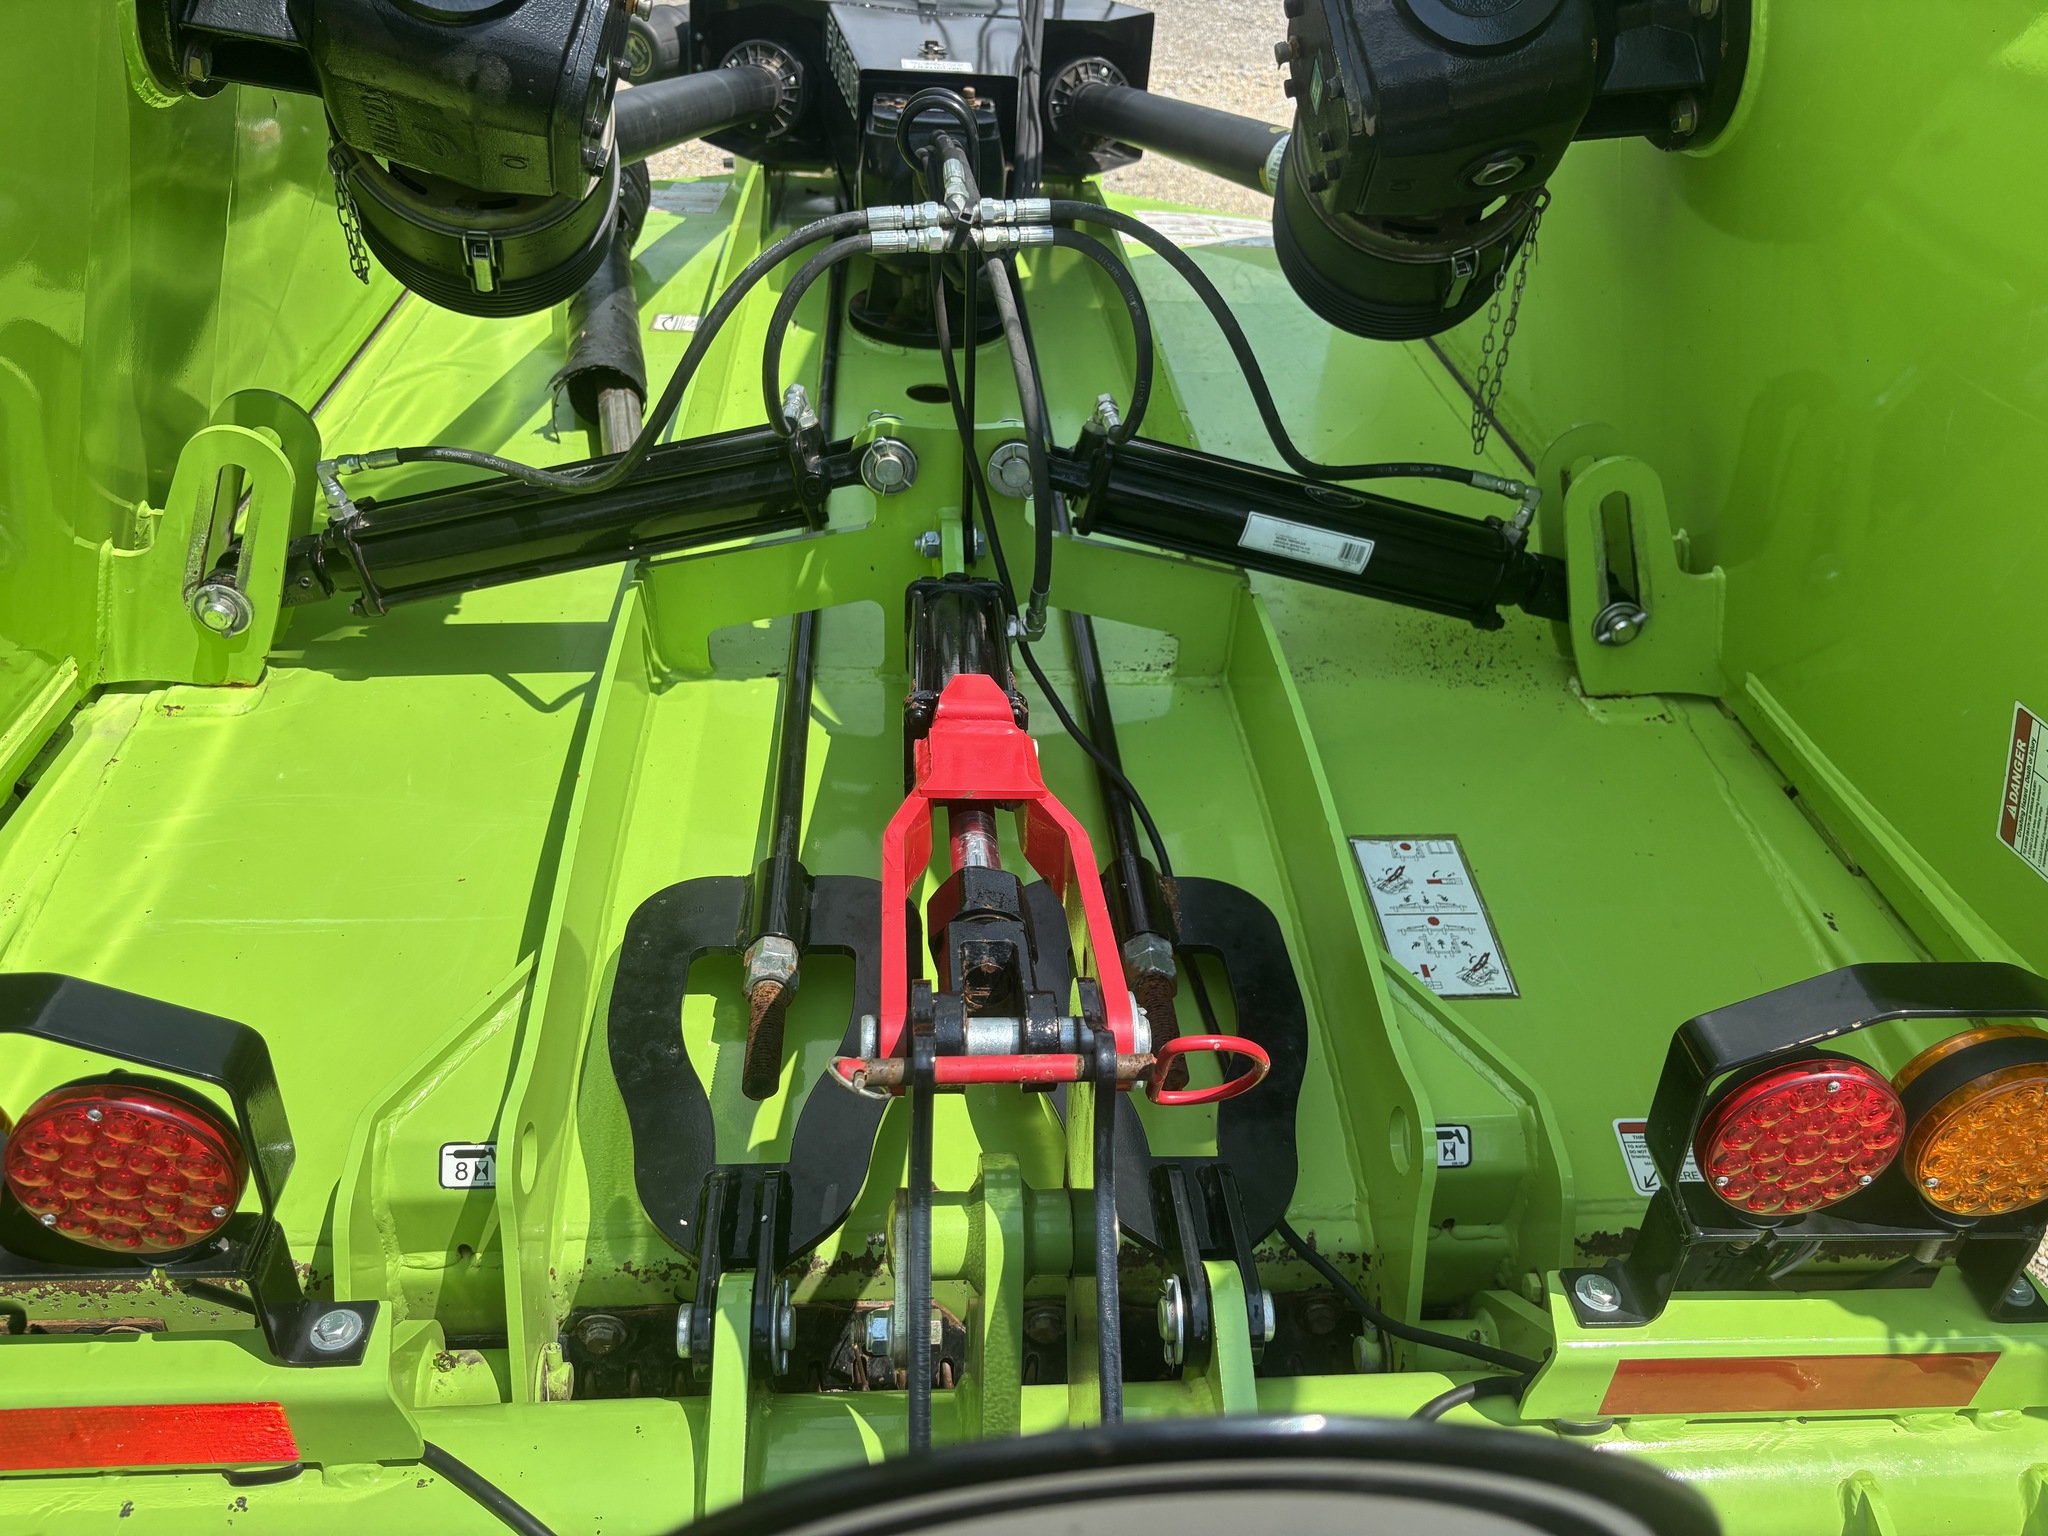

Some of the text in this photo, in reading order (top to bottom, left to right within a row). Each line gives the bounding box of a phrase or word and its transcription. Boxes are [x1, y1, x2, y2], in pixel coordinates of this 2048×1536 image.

[2028, 736, 2037, 757] Injury
[2009, 738, 2026, 806] DANGER
[2024, 764, 2032, 785] Death
[2021, 786, 2029, 811] Hazard
[2016, 809, 2026, 838] Crushing
[455, 1161, 468, 1181] 8
